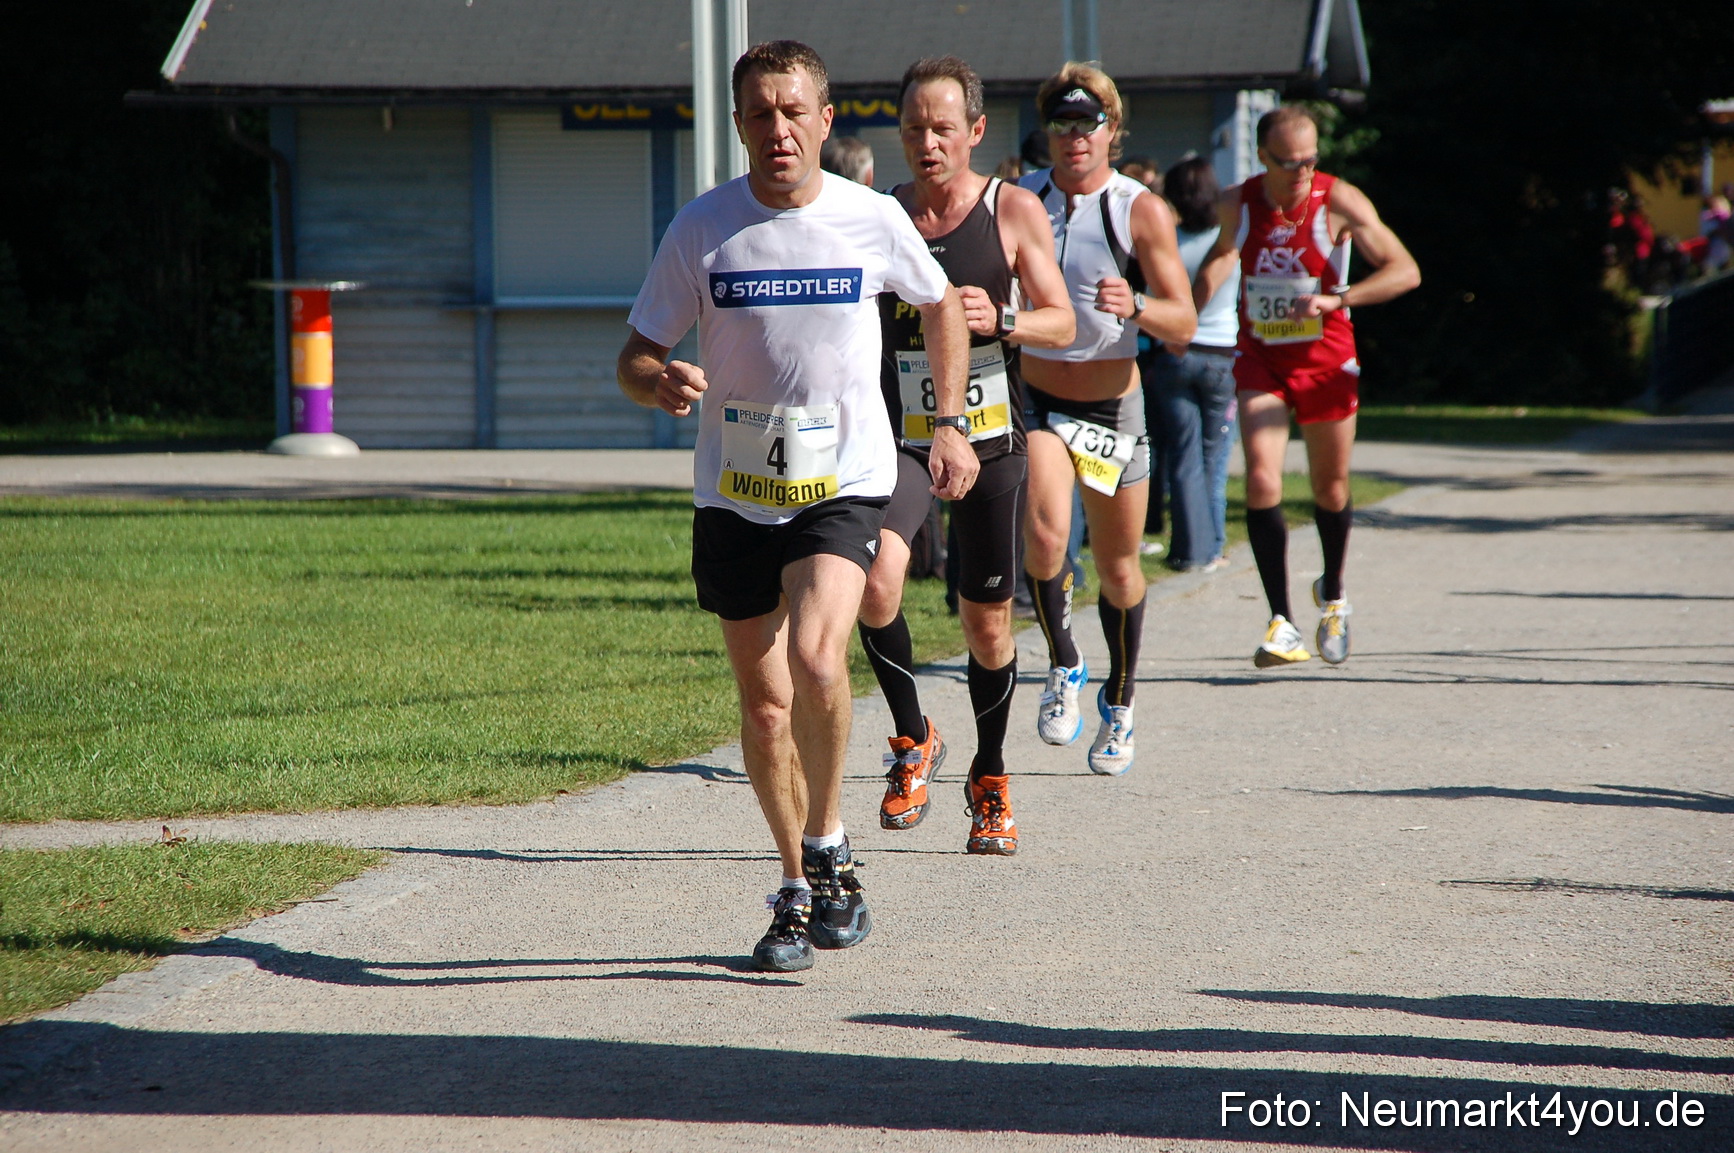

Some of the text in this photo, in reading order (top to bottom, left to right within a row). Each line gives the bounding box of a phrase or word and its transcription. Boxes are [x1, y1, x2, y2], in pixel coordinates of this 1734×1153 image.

[1254, 247, 1310, 278] ASK
[1259, 296, 1297, 320] 36
[921, 373, 983, 412] 85
[740, 409, 784, 427] PFLEIDERER
[925, 409, 986, 433] Rrt
[1068, 419, 1116, 458] 730
[766, 436, 788, 476] 4
[732, 472, 826, 506] Wolfgang
